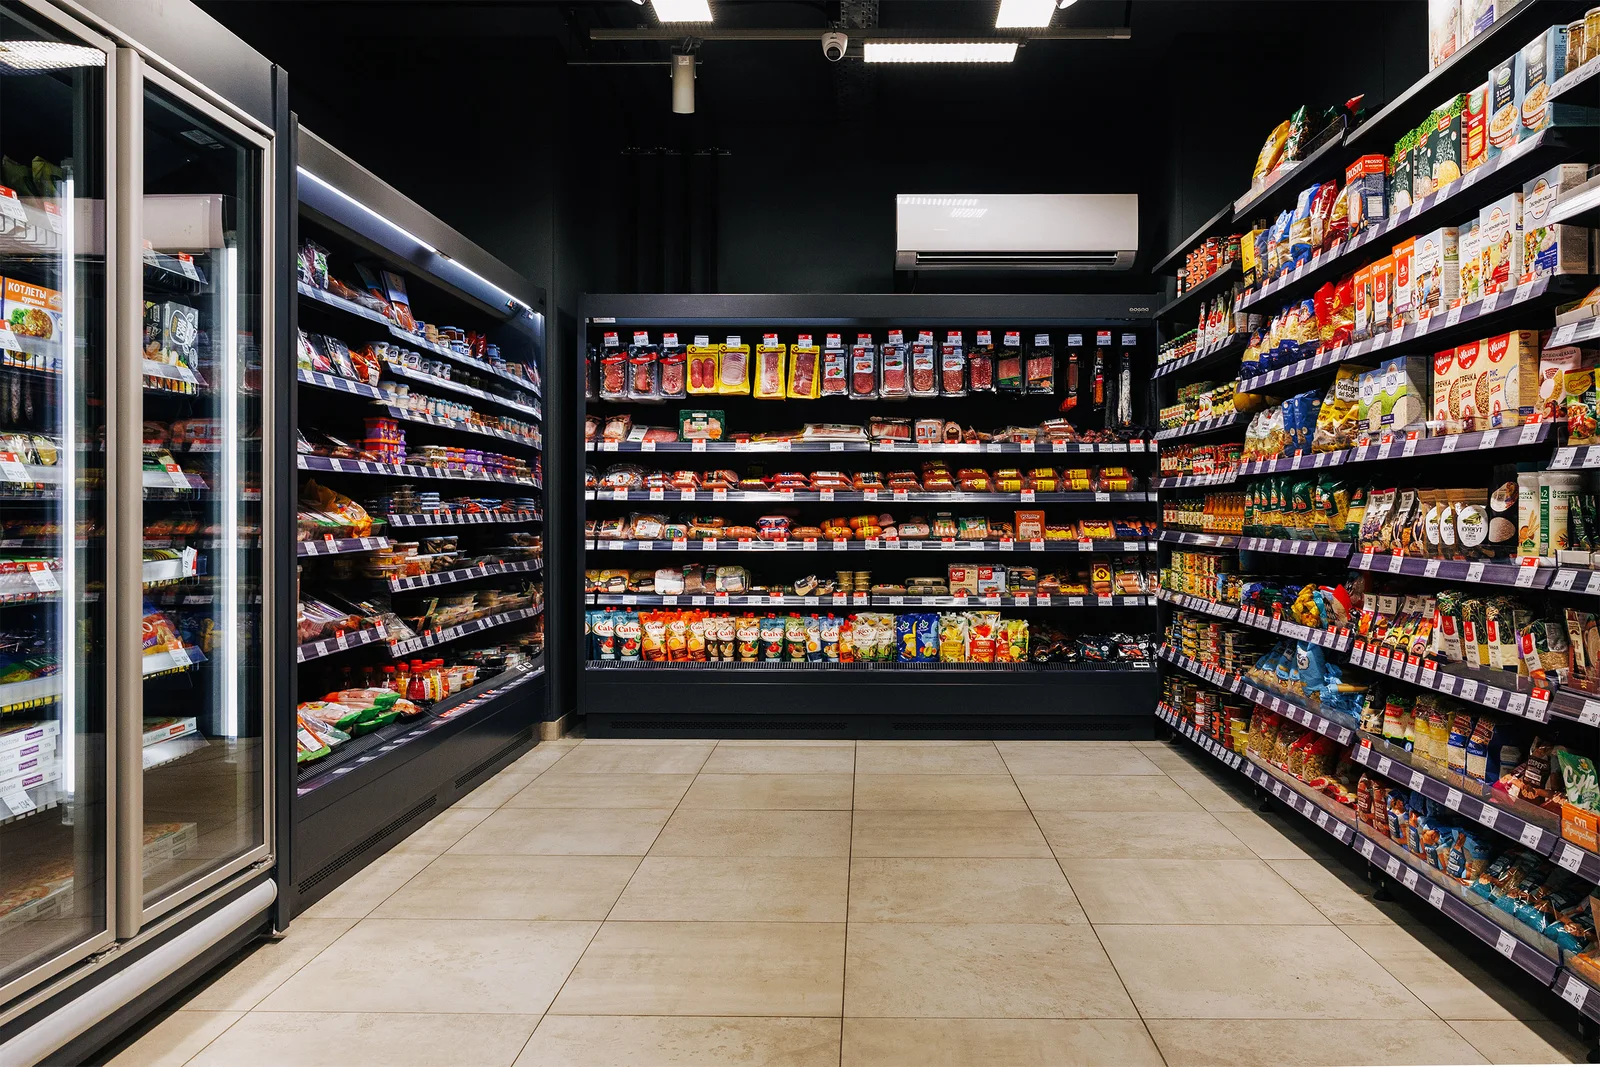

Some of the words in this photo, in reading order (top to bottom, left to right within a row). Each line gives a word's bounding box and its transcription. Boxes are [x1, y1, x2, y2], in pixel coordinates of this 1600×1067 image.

[8, 281, 47, 300] КОТЛЕТЫ
[21, 295, 46, 307] куриные
[1459, 373, 1477, 383] ГРЕЧКА
